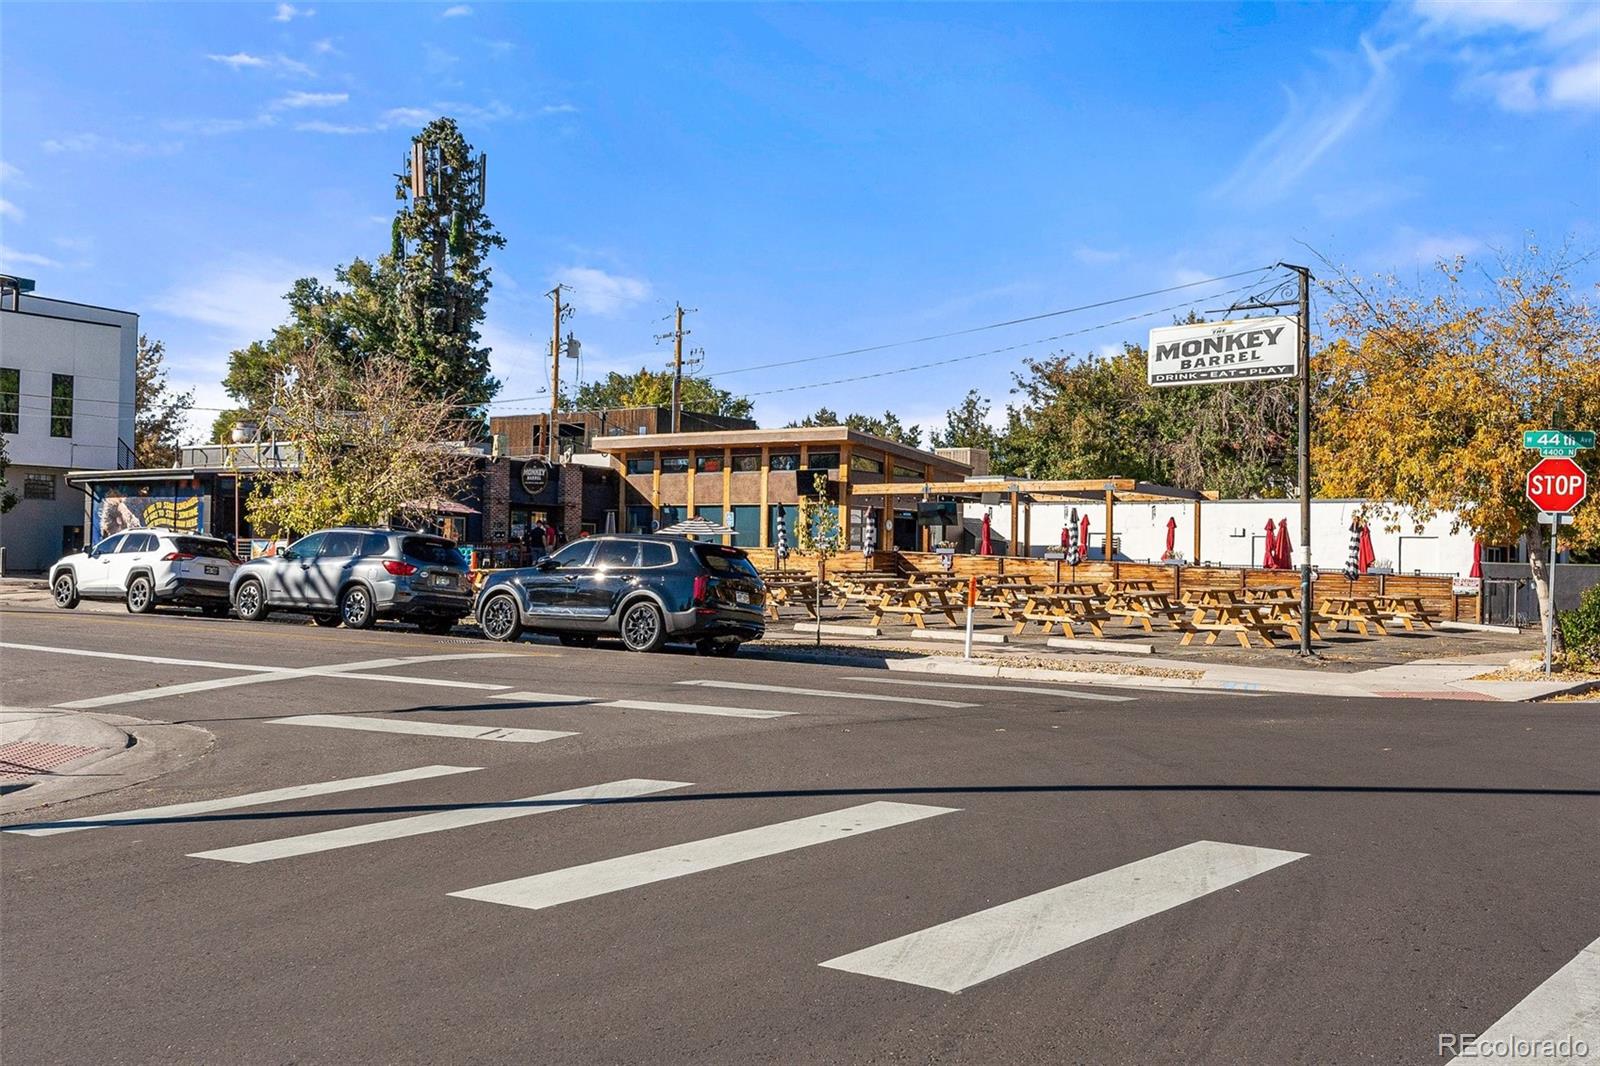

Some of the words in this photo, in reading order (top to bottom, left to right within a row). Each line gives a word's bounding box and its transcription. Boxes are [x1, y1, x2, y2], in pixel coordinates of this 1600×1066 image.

[1155, 327, 1285, 362] MONKEY
[1180, 350, 1261, 370] BARREL
[1156, 372, 1198, 382] DRINK
[1210, 369, 1237, 378] EAT
[1250, 366, 1287, 375] PLAY
[1531, 475, 1582, 495] STOP
